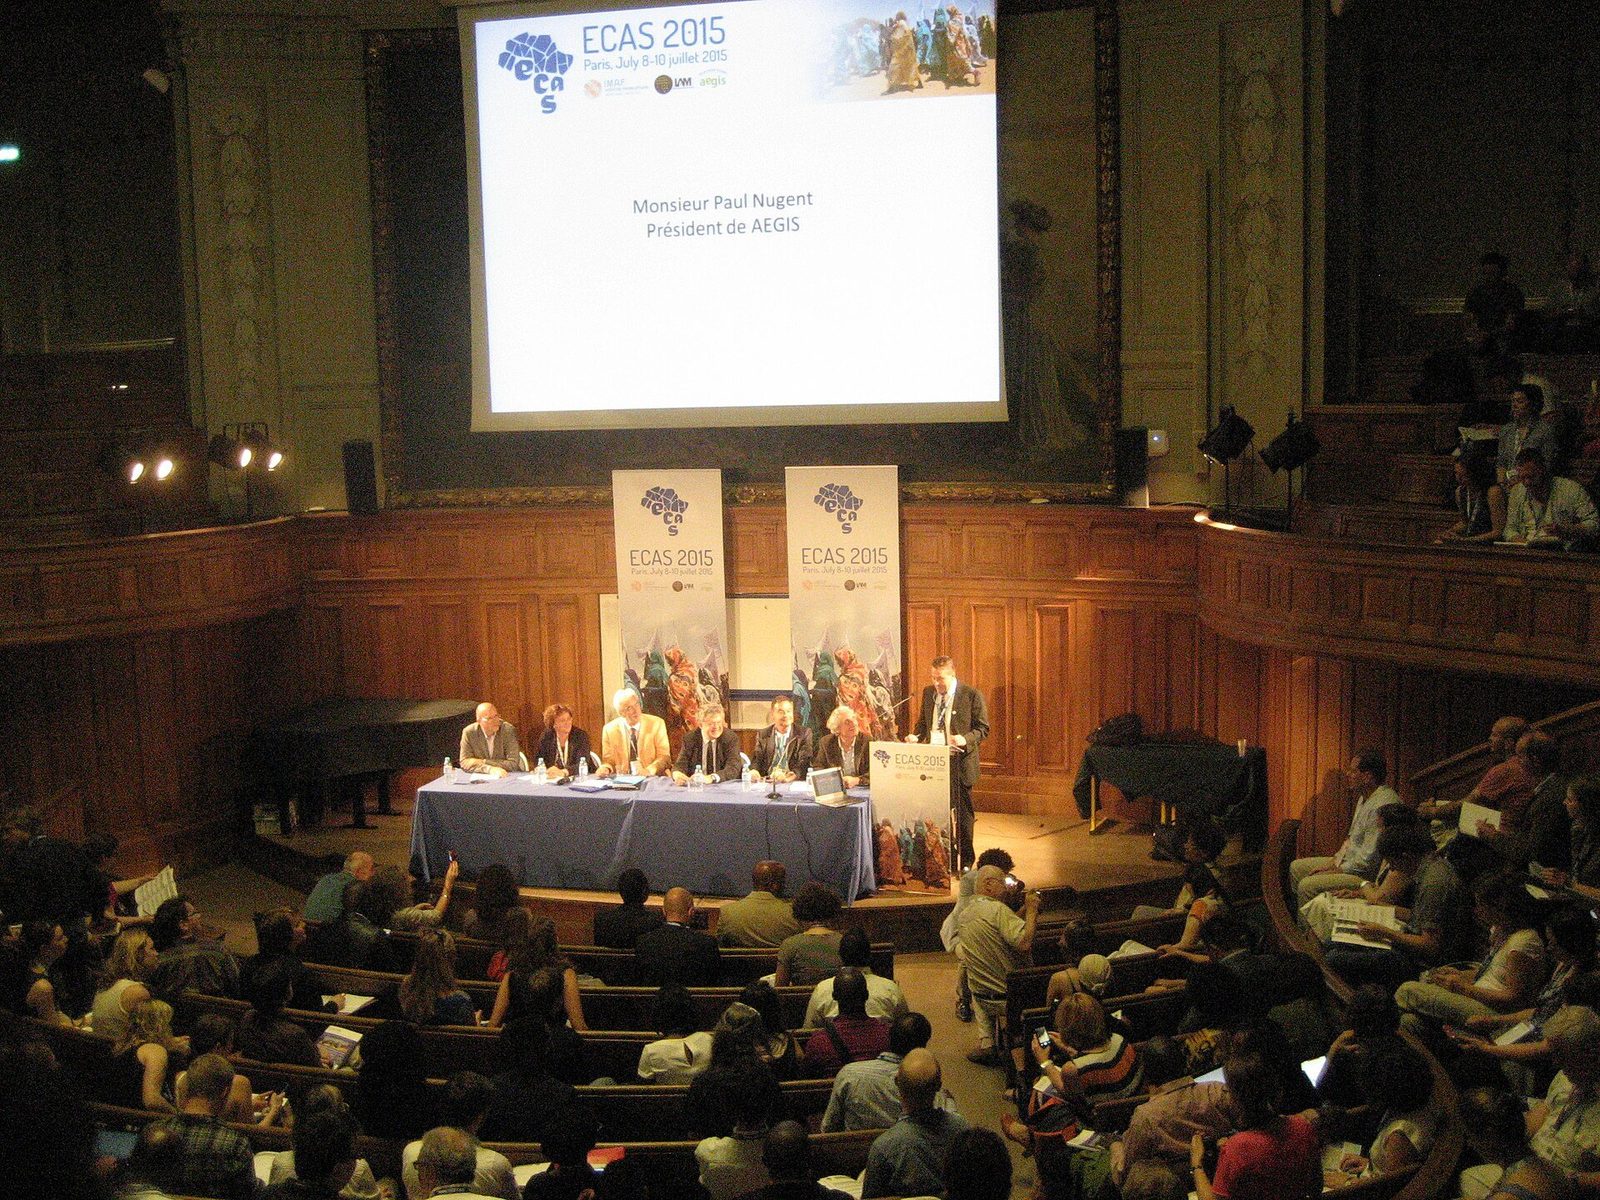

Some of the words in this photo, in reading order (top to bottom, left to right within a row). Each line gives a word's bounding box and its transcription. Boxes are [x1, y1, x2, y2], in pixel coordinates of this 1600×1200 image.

[583, 22, 654, 54] ECAS
[663, 16, 726, 48] 2015
[584, 58, 613, 71] Paris,
[615, 57, 639, 71] July
[642, 53, 666, 66] 8-10
[668, 51, 699, 69] juillet
[702, 49, 728, 63] 2015
[699, 76, 727, 89] aegis
[633, 197, 709, 214] Monsieur
[714, 193, 748, 210] Paul
[753, 191, 813, 210] Nugent
[647, 220, 722, 238] Président
[727, 219, 746, 235] de
[751, 216, 800, 234] AEGIS
[630, 549, 673, 566] ECAS
[677, 549, 714, 566] 2015
[801, 547, 845, 564] ECAS
[850, 547, 888, 564] 2015
[895, 754, 921, 765] ECAS
[923, 756, 946, 766] 2015
